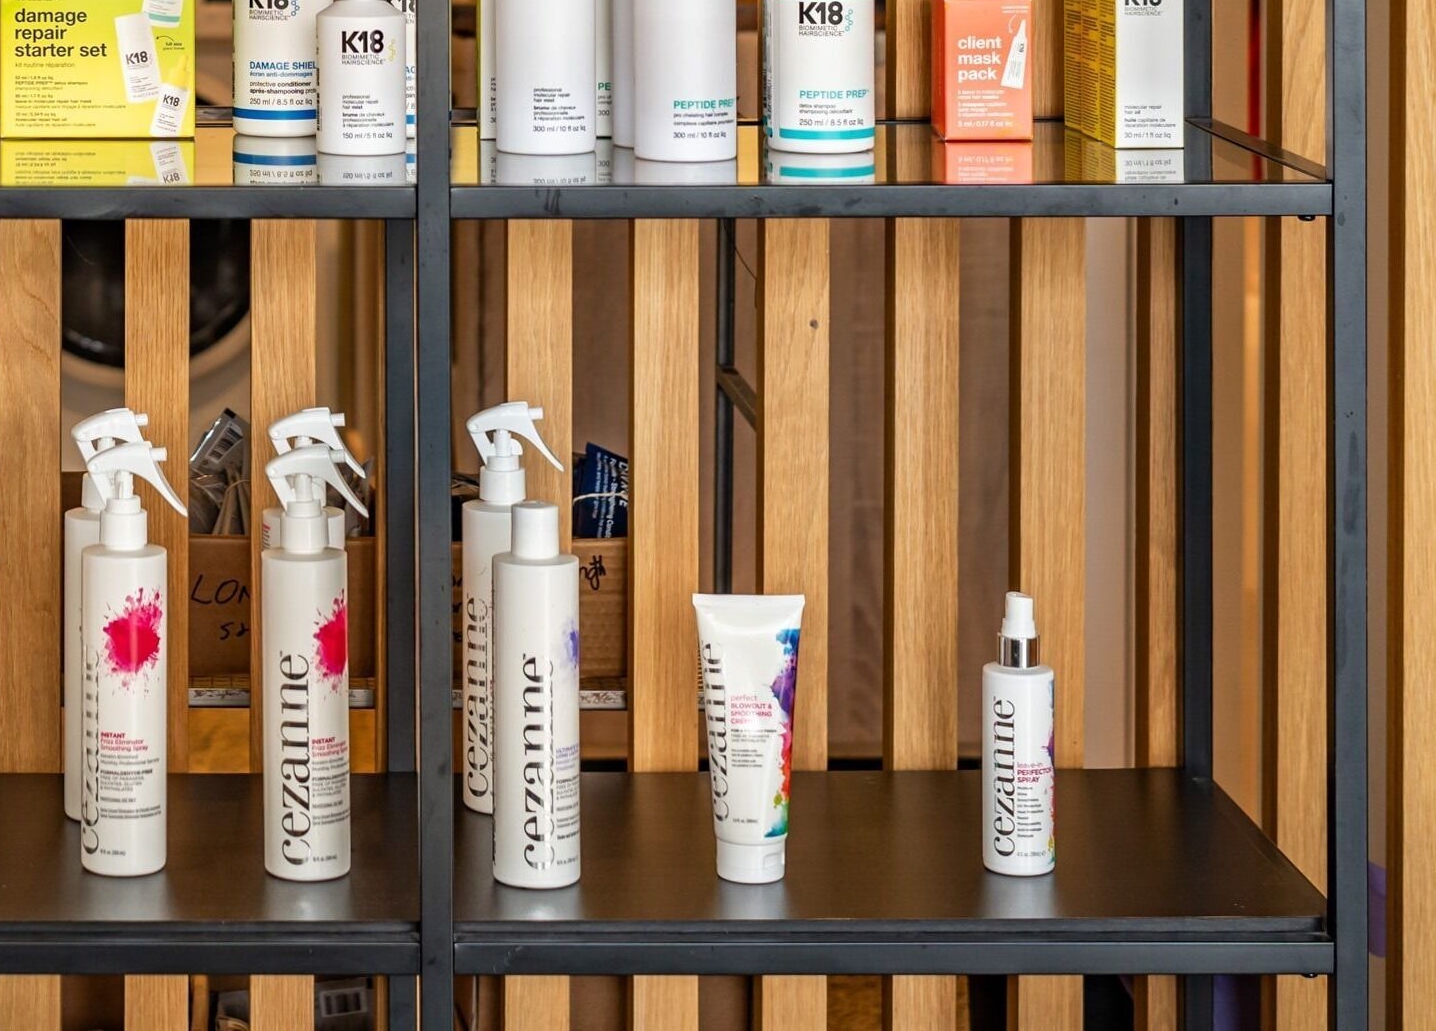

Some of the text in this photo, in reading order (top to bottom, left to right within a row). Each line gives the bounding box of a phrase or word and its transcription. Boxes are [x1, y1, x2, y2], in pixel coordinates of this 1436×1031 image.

[14, 8, 88, 26] damage
[798, 0, 844, 25] K18
[15, 25, 67, 43] repair
[341, 29, 385, 53] K18
[957, 35, 1002, 50] client
[14, 43, 107, 58] starter set
[125, 50, 148, 65] K18
[957, 50, 1002, 65] mask
[249, 61, 291, 71] DAMAGE
[957, 67, 997, 83] pack
[249, 80, 277, 88] protective
[799, 89, 844, 100] PEPTIDE
[162, 94, 181, 107] K18
[249, 97, 313, 107] 250 ml 8.5 fl oz liq
[673, 99, 717, 109] PEPTIDE
[532, 125, 545, 133] 300
[546, 125, 554, 133] ml
[377, 132, 386, 140] oz
[672, 131, 686, 139] 300
[687, 131, 696, 139] ml
[467, 597, 489, 798] cezanne
[730, 694, 758, 704] perfect
[730, 702, 767, 710] BLOWOUT
[100, 731, 126, 739] INSTANT
[311, 736, 336, 745] INSTANT
[114, 737, 144, 745] Eliminator
[100, 744, 149, 752] Smoothing Spray
[279, 652, 311, 866] cezanne
[522, 655, 555, 871] cezanne
[993, 699, 1016, 858] cezanne
[1017, 776, 1040, 784] SPRAY
